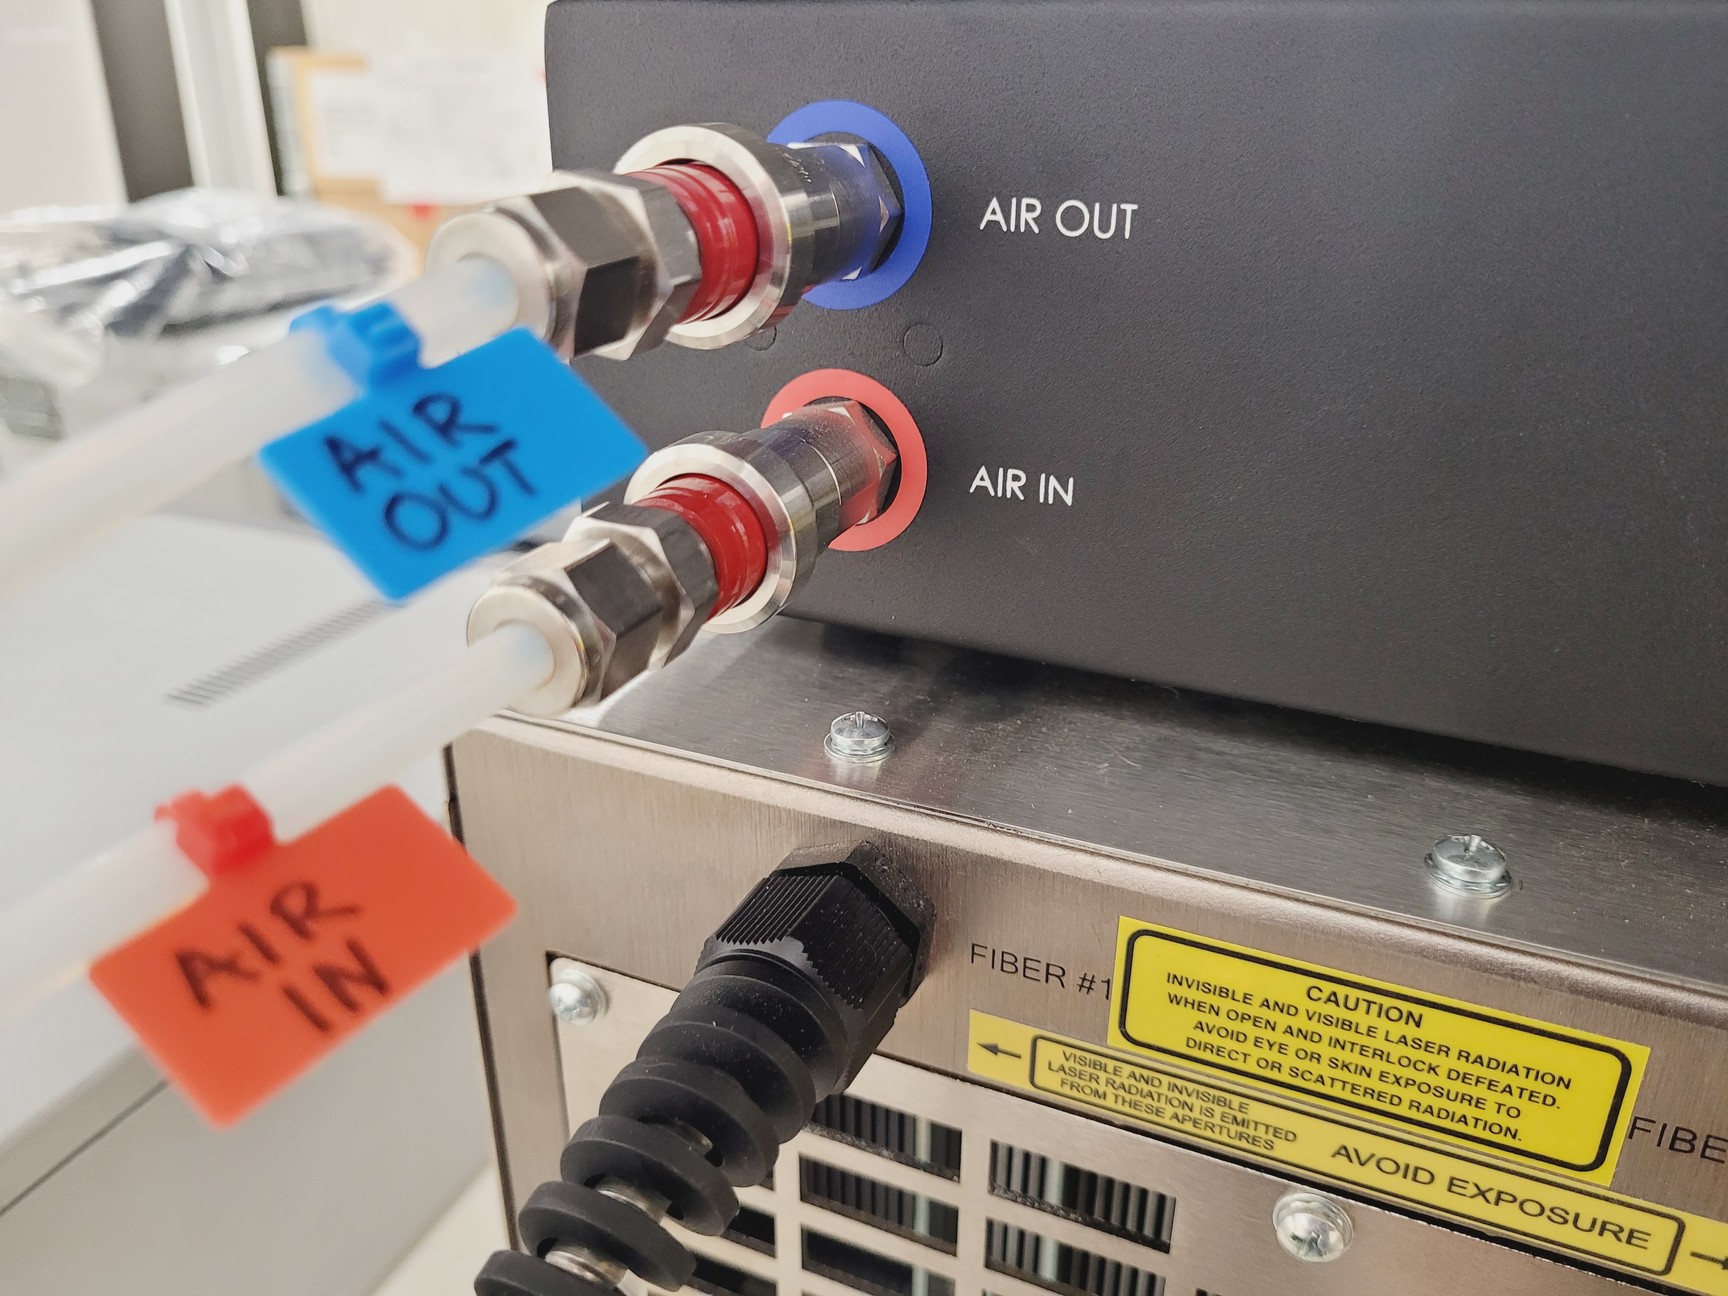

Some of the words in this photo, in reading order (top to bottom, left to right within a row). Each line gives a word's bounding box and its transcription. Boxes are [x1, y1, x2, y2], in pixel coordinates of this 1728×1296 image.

[979, 196, 1042, 234] AIR
[1055, 199, 1139, 240] OUT
[324, 392, 500, 495] AIR
[969, 465, 1027, 500] AIR
[1039, 472, 1074, 506] IN
[384, 438, 539, 552] OUT
[173, 880, 362, 1011] AIR
[283, 936, 391, 1035] IN
[970, 943, 1066, 989] FIBER
[1077, 972, 1111, 1000] #1
[1166, 972, 1253, 1005] INVISIBLE
[1259, 998, 1299, 1017] AND
[1305, 1009, 1379, 1038] VISIBLE
[1384, 1030, 1451, 1058] LASER
[1456, 1049, 1572, 1090] RADIATION
[1167, 992, 1220, 1017] WHEN
[1226, 1009, 1277, 1032] OPEN
[1282, 1025, 1322, 1044] AND
[1328, 1036, 1440, 1076] INTERLOCK
[1447, 1068, 1561, 1110] DEFEATED.
[1306, 985, 1423, 1028] CAUTION
[1047, 1060, 1101, 1086] LASER
[1105, 1077, 1194, 1113] RADIATION
[1199, 1104, 1215, 1119] IS
[1220, 1113, 1298, 1143] EMITTED
[1060, 1077, 1107, 1101] FROM
[1113, 1093, 1166, 1119] THESE
[1169, 1111, 1275, 1151] APERTURES
[1062, 1050, 1123, 1078] VISIBLE
[1127, 1070, 1162, 1089] AND
[1167, 1081, 1249, 1115] INVISIBLE
[1186, 1037, 1251, 1064] DIRECT
[1256, 1057, 1283, 1074] OR
[1288, 1066, 1403, 1107] SCATTERED
[1408, 1099, 1522, 1142] RADIATION.
[1193, 1020, 1248, 1044] AVOID
[1253, 1037, 1289, 1055] EYE
[1295, 1048, 1322, 1065] OR
[1328, 1057, 1373, 1079] SKIN
[1378, 1071, 1486, 1111] EXPOSURE
[1494, 1102, 1521, 1119] TO
[1331, 1144, 1435, 1186] AVOID
[1446, 1176, 1652, 1250] EXPOSURE
